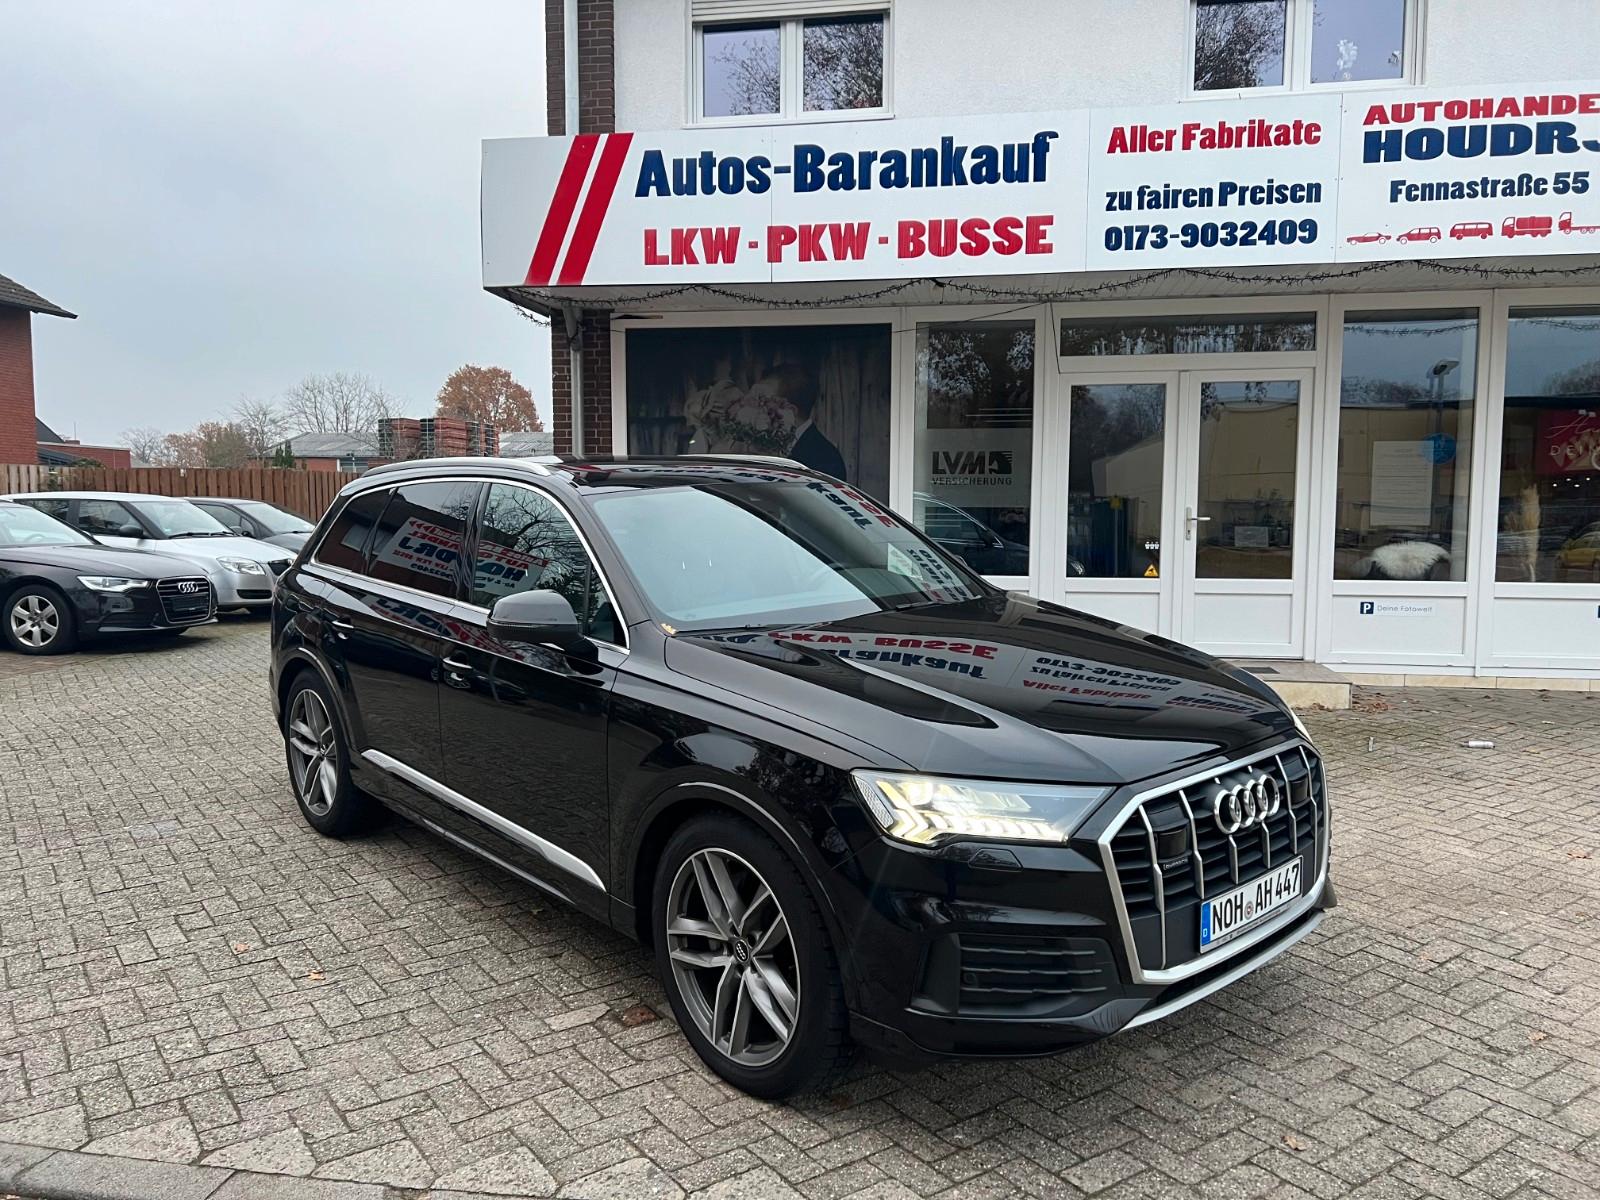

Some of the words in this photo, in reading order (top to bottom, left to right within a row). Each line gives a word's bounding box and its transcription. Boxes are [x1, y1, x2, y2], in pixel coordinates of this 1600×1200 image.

[1107, 125, 1176, 154] Aller
[1182, 119, 1322, 151] Fabrikate
[635, 130, 1059, 198] Autos-Barankauf
[1105, 190, 1133, 212] zu
[1137, 184, 1214, 211] fairen
[1218, 178, 1322, 207] Preisen
[1390, 173, 1548, 203] Fennastraße
[1553, 171, 1590, 195] 55
[643, 226, 741, 266] LKW
[767, 222, 871, 263] PKW
[897, 215, 1054, 259] BUSSE
[1104, 217, 1318, 251] 0173-9032409
[932, 451, 986, 475] LVM
[932, 477, 1012, 486] VERSICHERUNG
[1212, 891, 1244, 935] NOH
[1255, 877, 1273, 914] AH
[1275, 863, 1300, 900] 447
